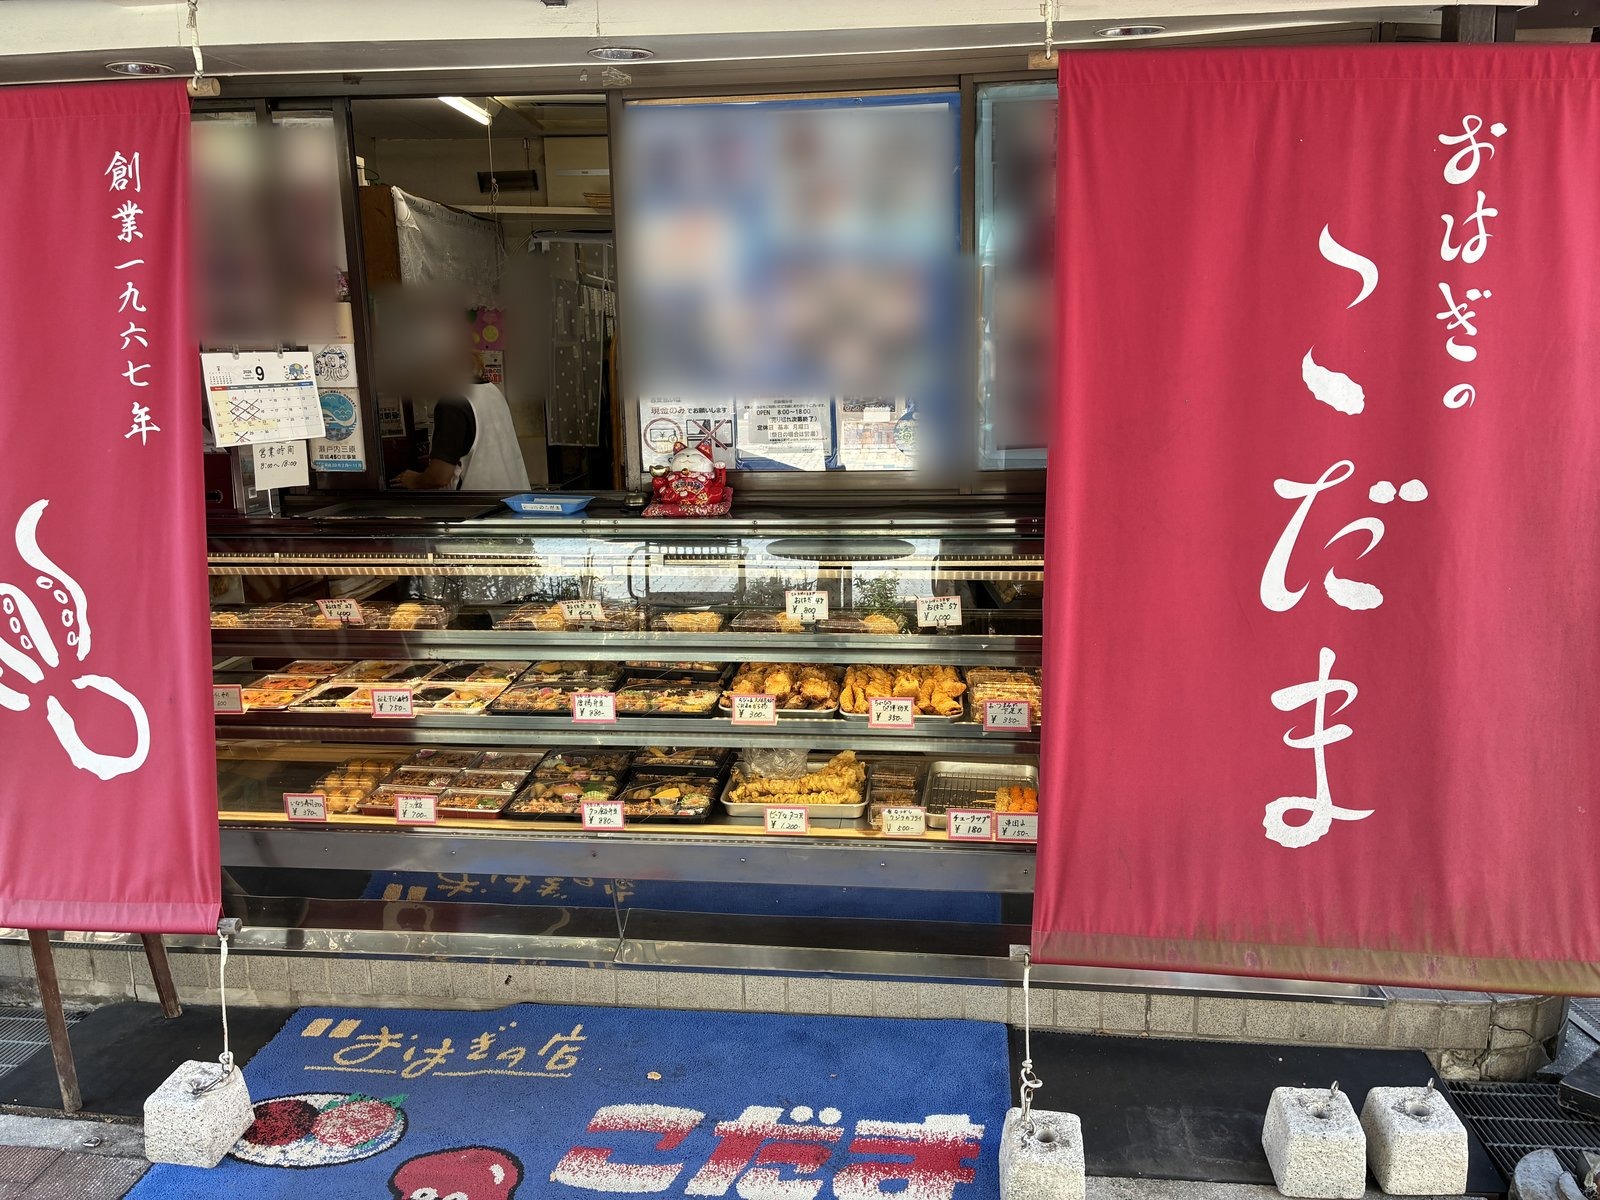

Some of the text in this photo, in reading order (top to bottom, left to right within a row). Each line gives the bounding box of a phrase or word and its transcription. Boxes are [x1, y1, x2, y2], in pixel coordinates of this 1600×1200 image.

[1437, 113, 1508, 409] おはぎの
[104, 150, 161, 447] 創業一九六七年
[255, 366, 265, 381] 9
[1260, 222, 1429, 850] こだま
[794, 596, 813, 604] おはぎ
[792, 605, 798, 613] ¥
[927, 602, 947, 611] おはぎ
[924, 612, 930, 621] ¥
[378, 703, 384, 711] ¥
[579, 708, 585, 717] ¥
[739, 709, 744, 718] ¥
[876, 712, 882, 721] ¥
[991, 715, 997, 724] ¥
[292, 807, 298, 815] ¥
[402, 809, 407, 818] ¥
[589, 815, 594, 824] ¥
[953, 814, 991, 824] チューリップ
[771, 820, 777, 829] ¥
[886, 823, 892, 832] ¥
[955, 825, 982, 834] ¥ 180
[1002, 827, 1008, 836] ¥
[333, 1021, 588, 1079] おはぎの店
[549, 1103, 986, 1200] こだま
